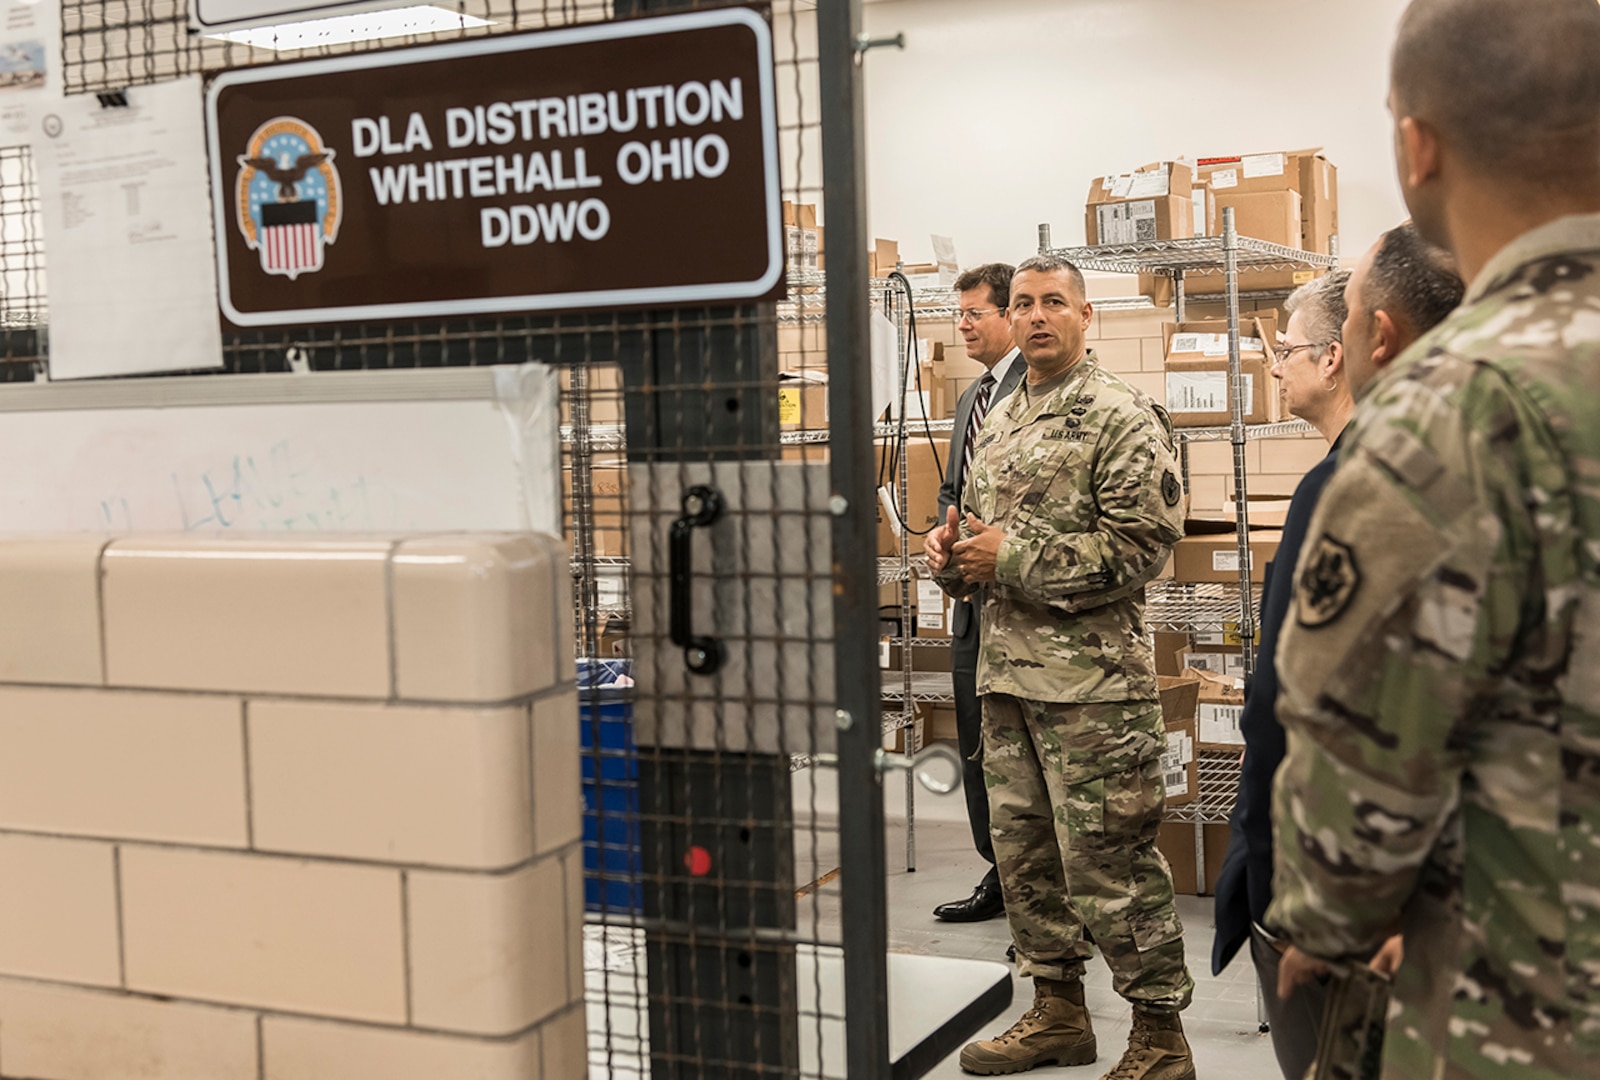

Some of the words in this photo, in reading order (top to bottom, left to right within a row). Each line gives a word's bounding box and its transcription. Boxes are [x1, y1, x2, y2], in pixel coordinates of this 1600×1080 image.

[351, 112, 433, 158] DLA
[445, 77, 743, 149] DISTRIBUTION
[369, 147, 602, 205] WHITEHALL
[616, 133, 730, 186] OHIO
[480, 198, 611, 248] DDWO
[1064, 431, 1088, 441] ARMY
